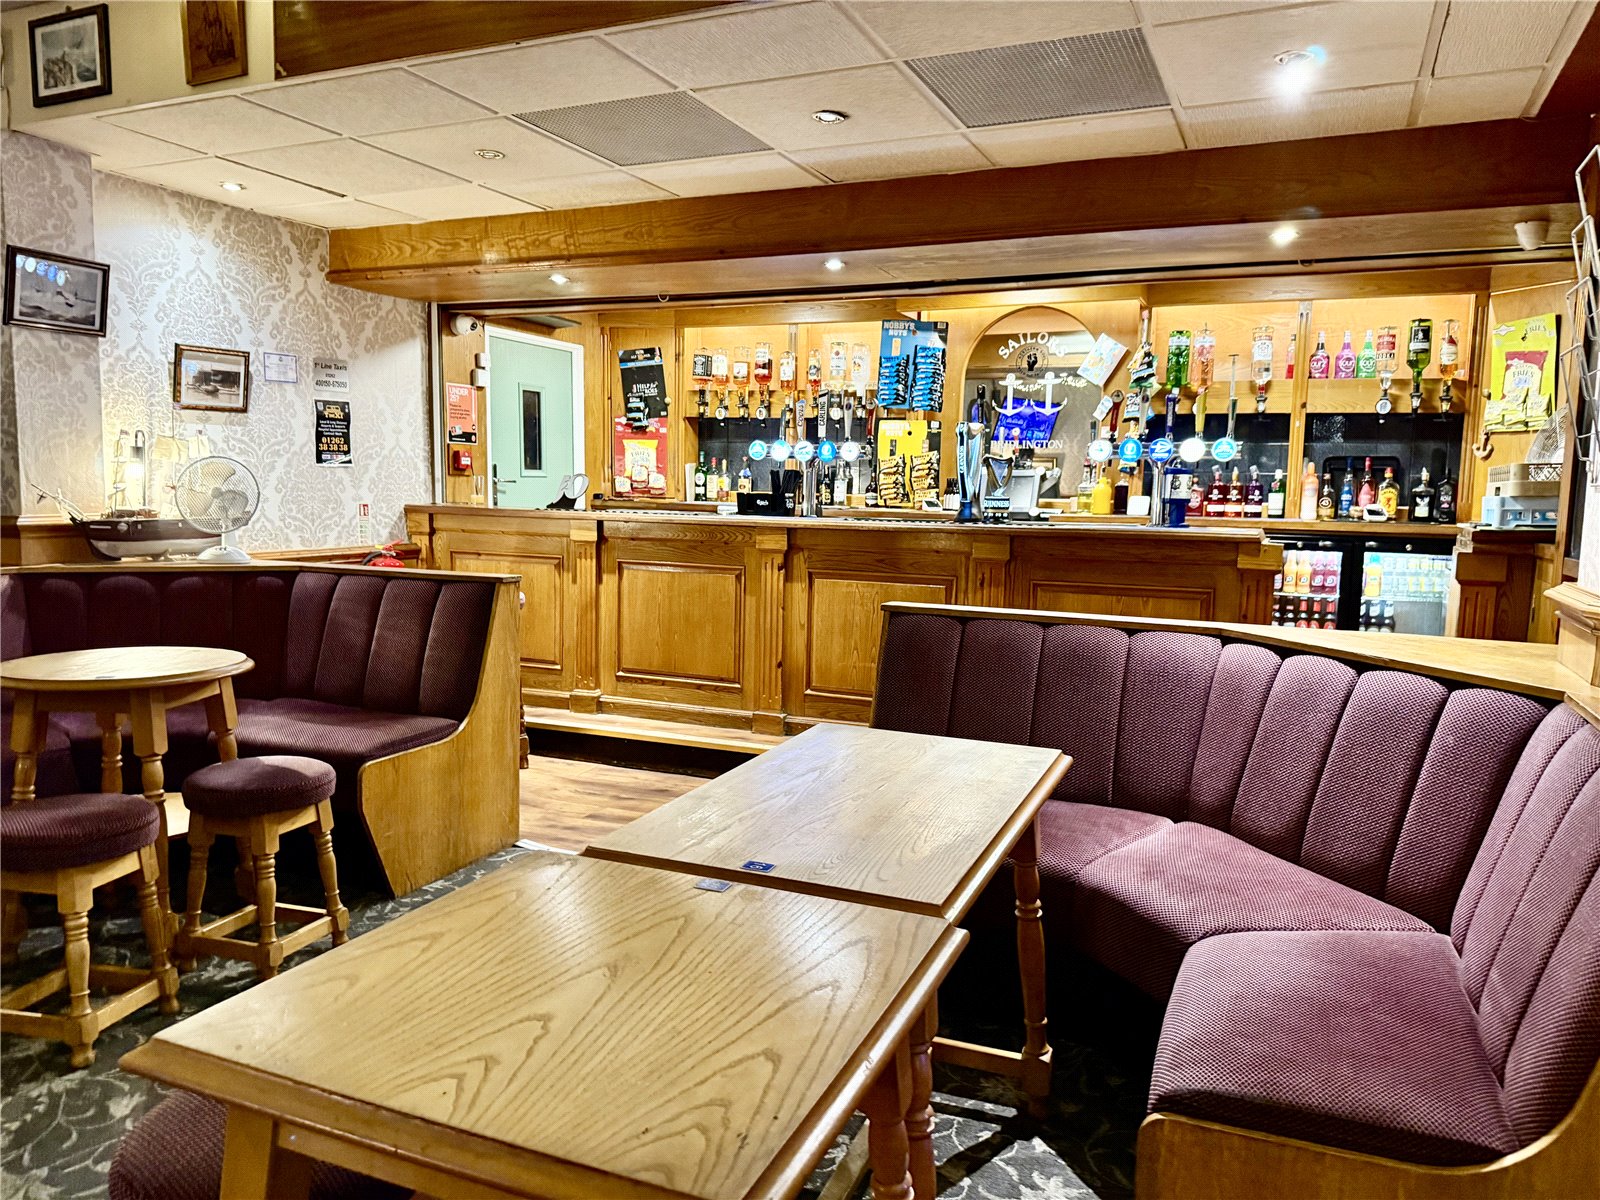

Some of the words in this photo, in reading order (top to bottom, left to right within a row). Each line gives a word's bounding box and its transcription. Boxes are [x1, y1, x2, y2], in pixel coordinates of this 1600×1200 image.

[883, 321, 915, 330] NOBBY'S
[998, 331, 1068, 360] SAILORS
[818, 401, 827, 427] CARLING
[990, 439, 1064, 449] BRIDLINGTON
[983, 500, 1010, 508] GUINNESS
